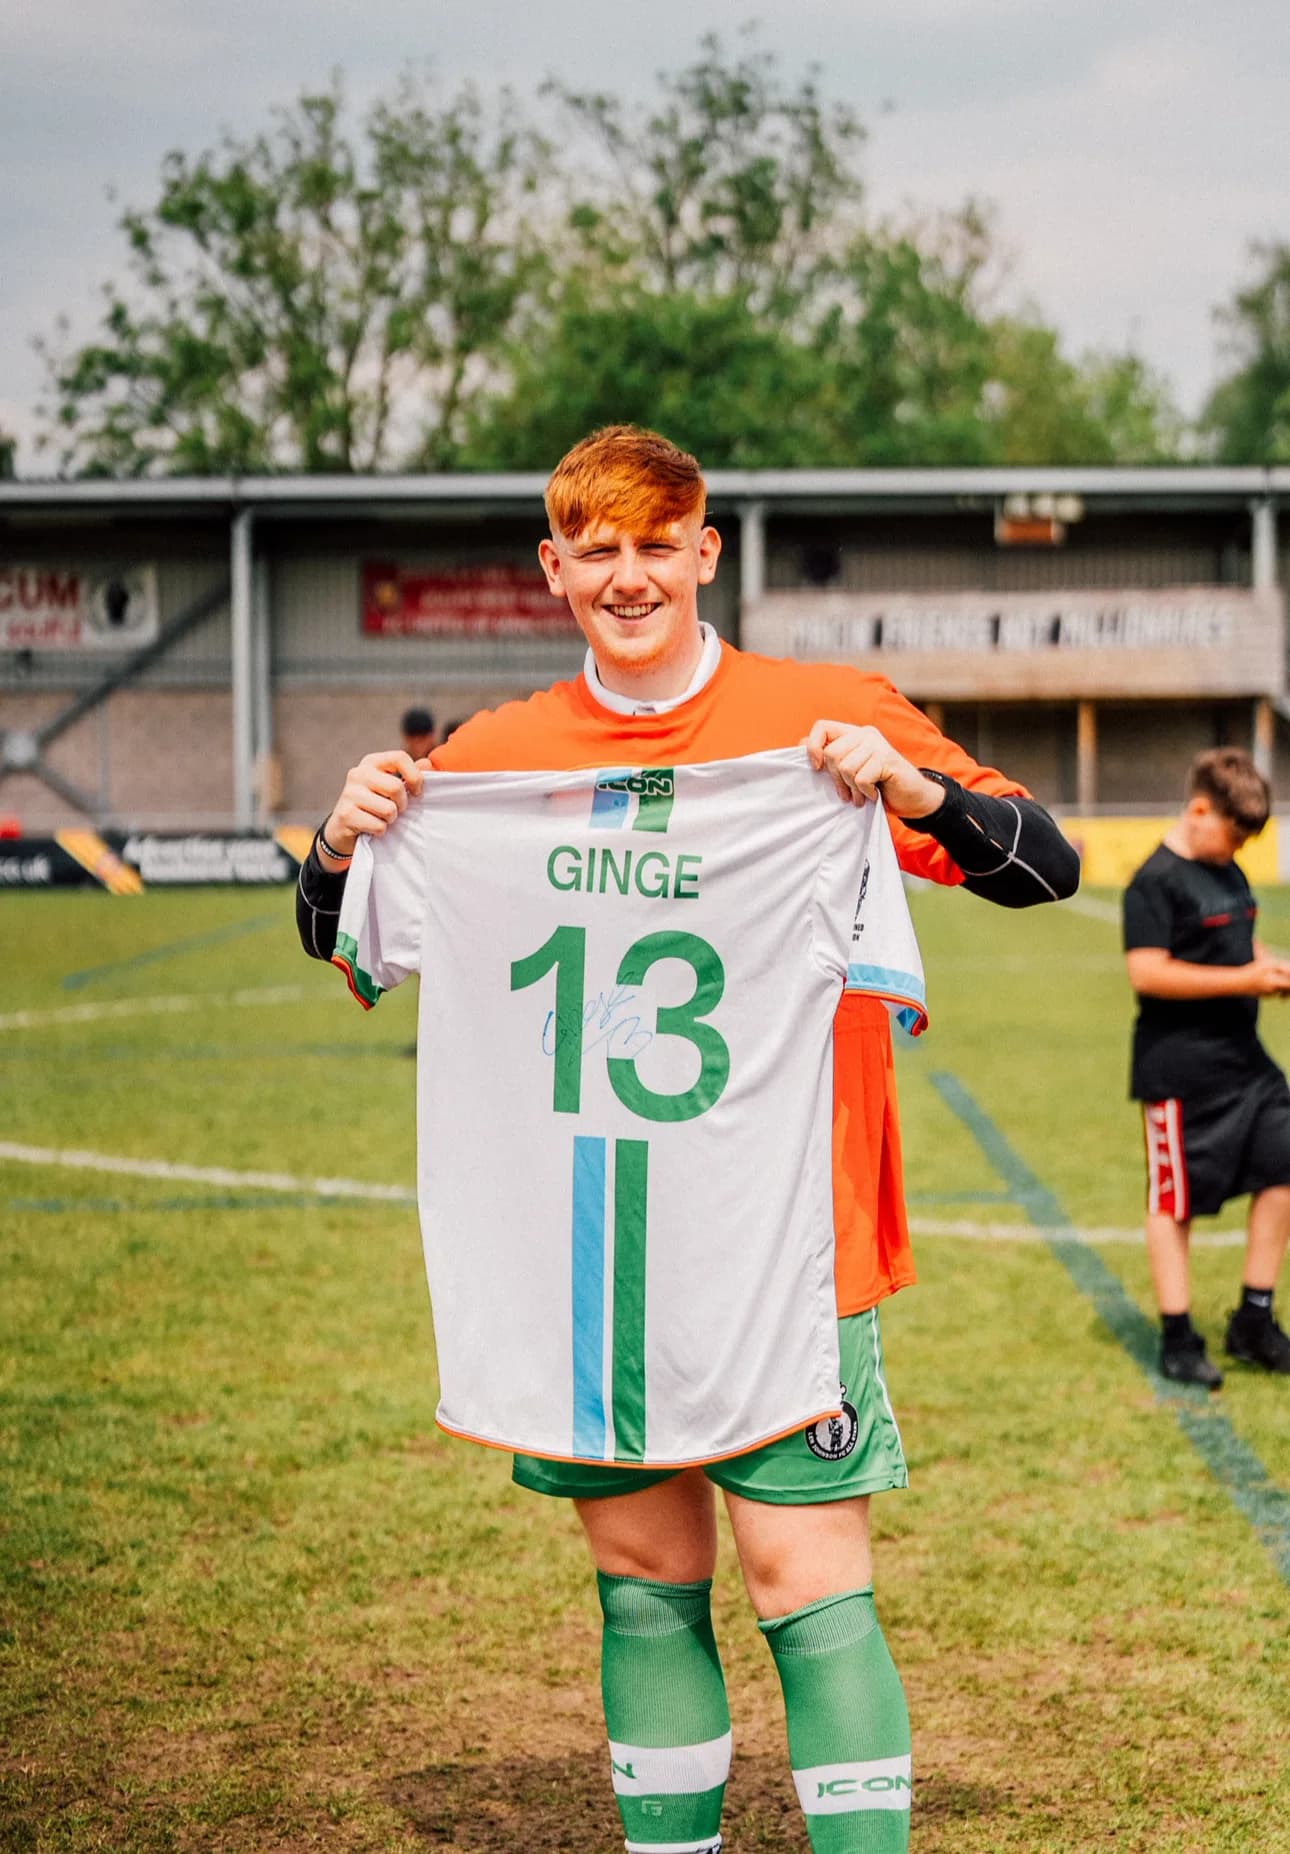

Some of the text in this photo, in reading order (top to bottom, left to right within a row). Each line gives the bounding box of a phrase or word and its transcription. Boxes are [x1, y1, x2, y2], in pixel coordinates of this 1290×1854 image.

[546, 845, 703, 899] GINGE
[510, 925, 730, 1123] 13
[816, 1775, 911, 1798] ICON
